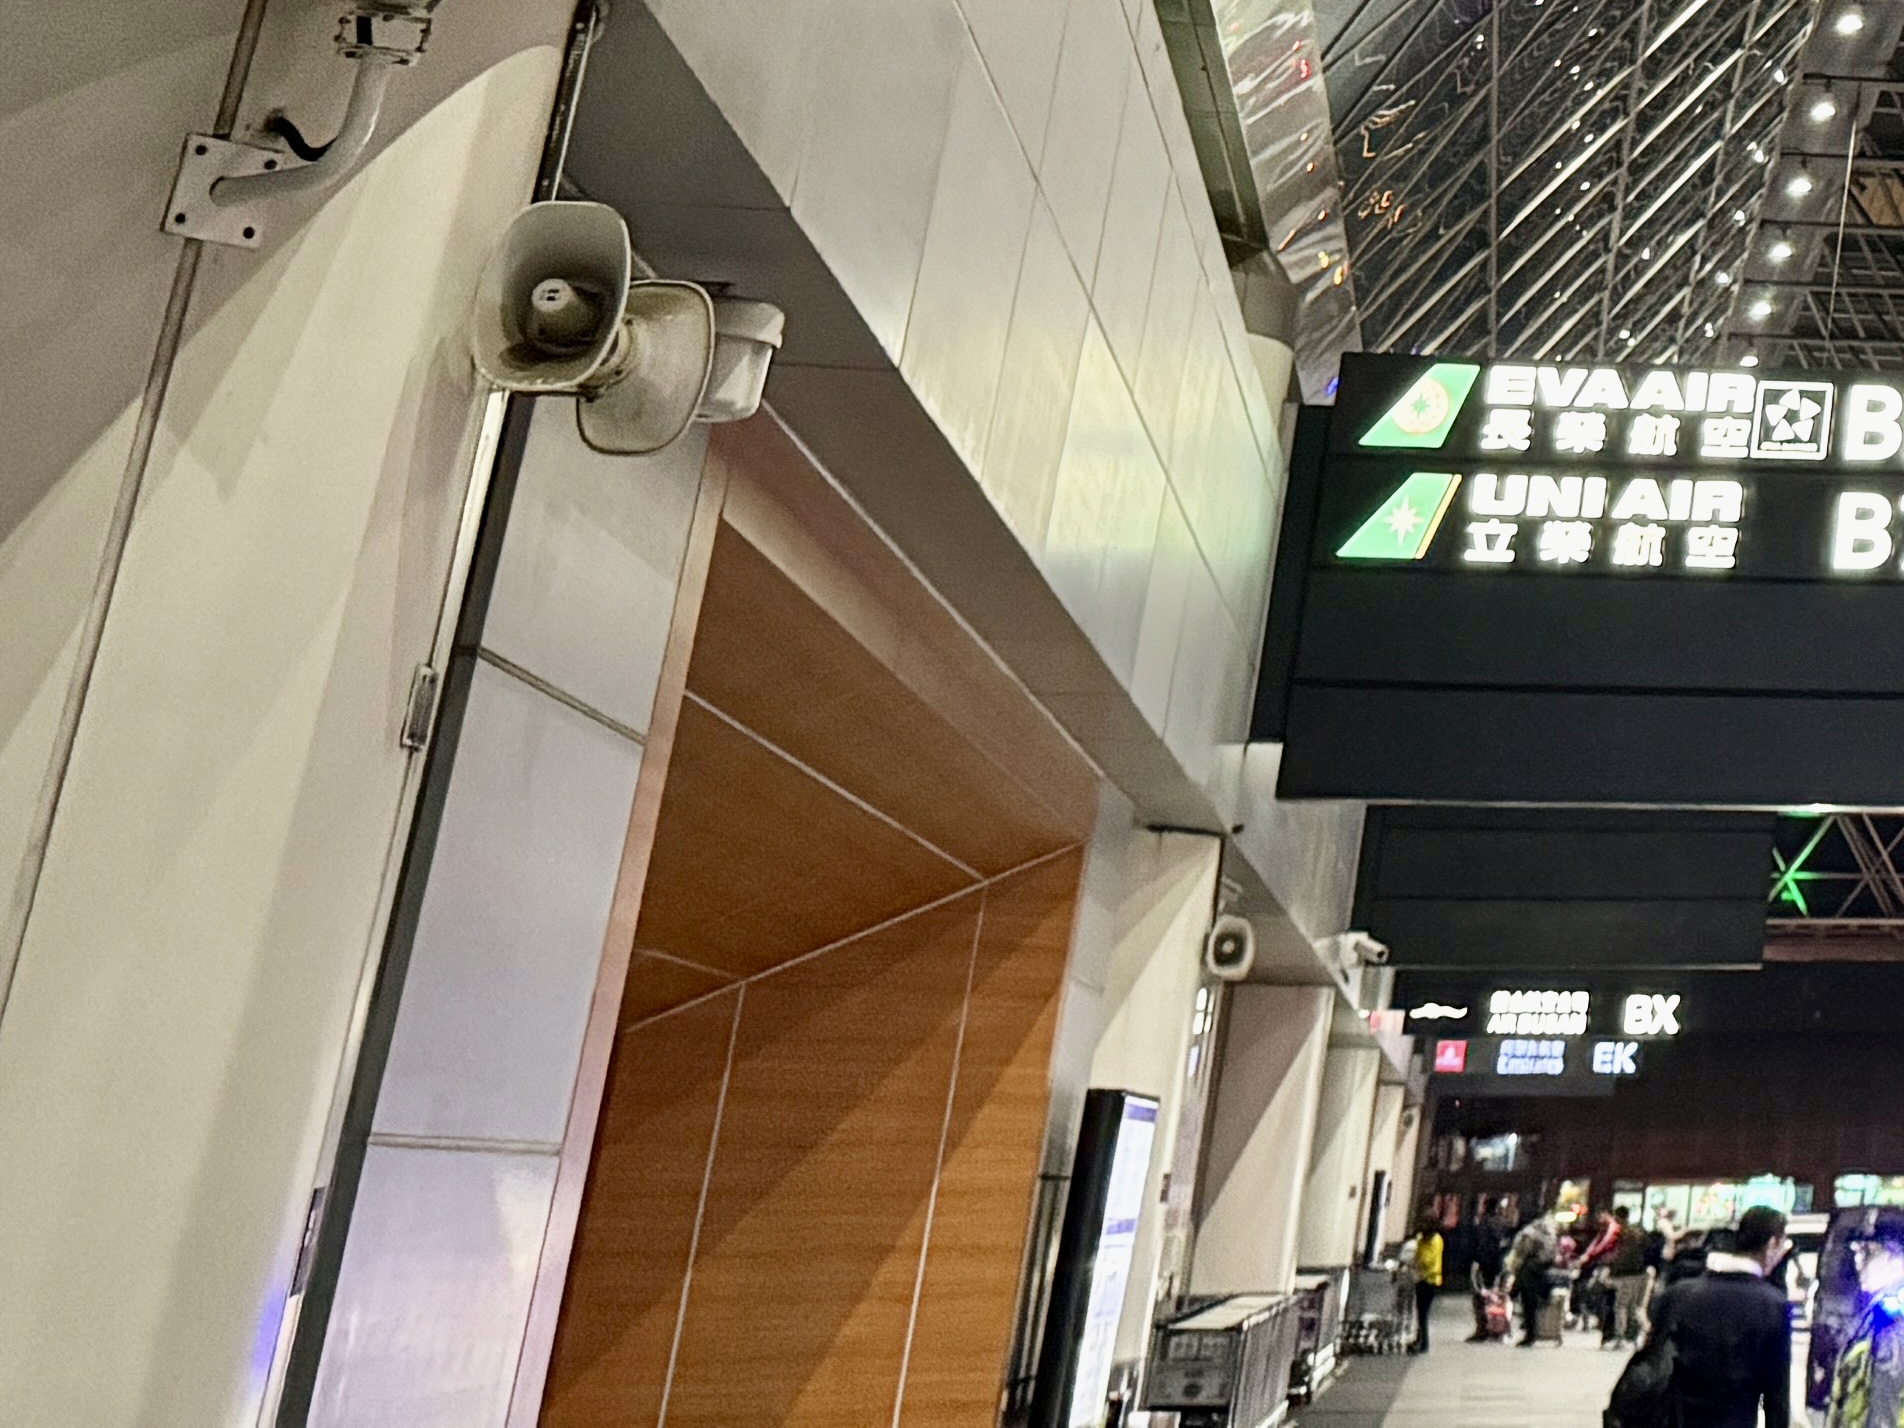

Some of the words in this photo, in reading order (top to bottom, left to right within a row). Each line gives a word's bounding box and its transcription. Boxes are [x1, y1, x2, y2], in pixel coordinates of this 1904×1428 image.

[1468, 473, 1607, 519] UNI
[1611, 478, 1743, 522] AIR
[1623, 993, 1681, 1036] BX
[1592, 1041, 1639, 1074] EK
